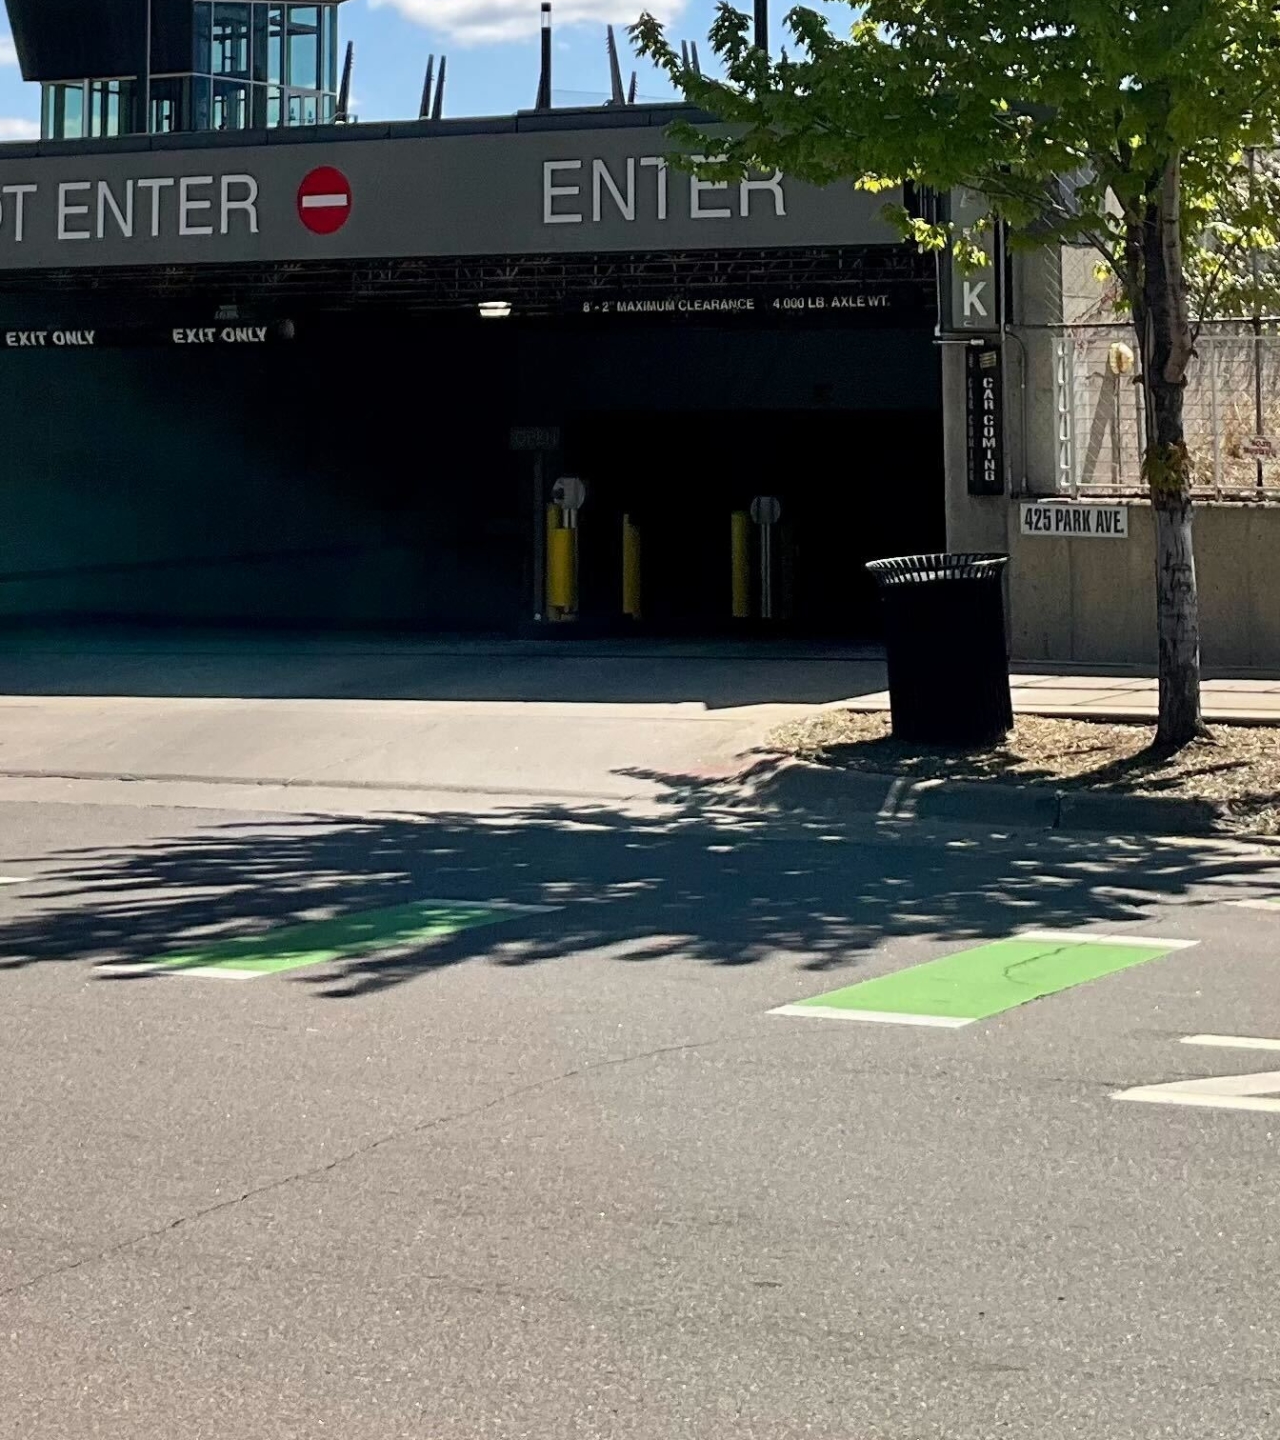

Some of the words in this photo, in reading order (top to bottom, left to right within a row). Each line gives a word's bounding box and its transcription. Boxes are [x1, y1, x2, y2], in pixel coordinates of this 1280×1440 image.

[543, 153, 787, 224] ENTER
[57, 173, 259, 240] ENTER
[616, 300, 675, 312] MAXIMUM
[677, 298, 755, 311] CLEARANCE
[807, 296, 829, 309] LB.
[831, 295, 866, 308] AXLE
[868, 294, 891, 308] WT.
[5, 331, 48, 347] EXIT
[52, 330, 96, 346] ONLY
[172, 327, 216, 344] EXIT
[220, 326, 268, 343] ONLY
[982, 377, 994, 410] CAR
[982, 414, 996, 481] COMING
[1024, 507, 1052, 531] 425
[1055, 508, 1092, 533] PARK
[1095, 509, 1125, 534] AVE.
